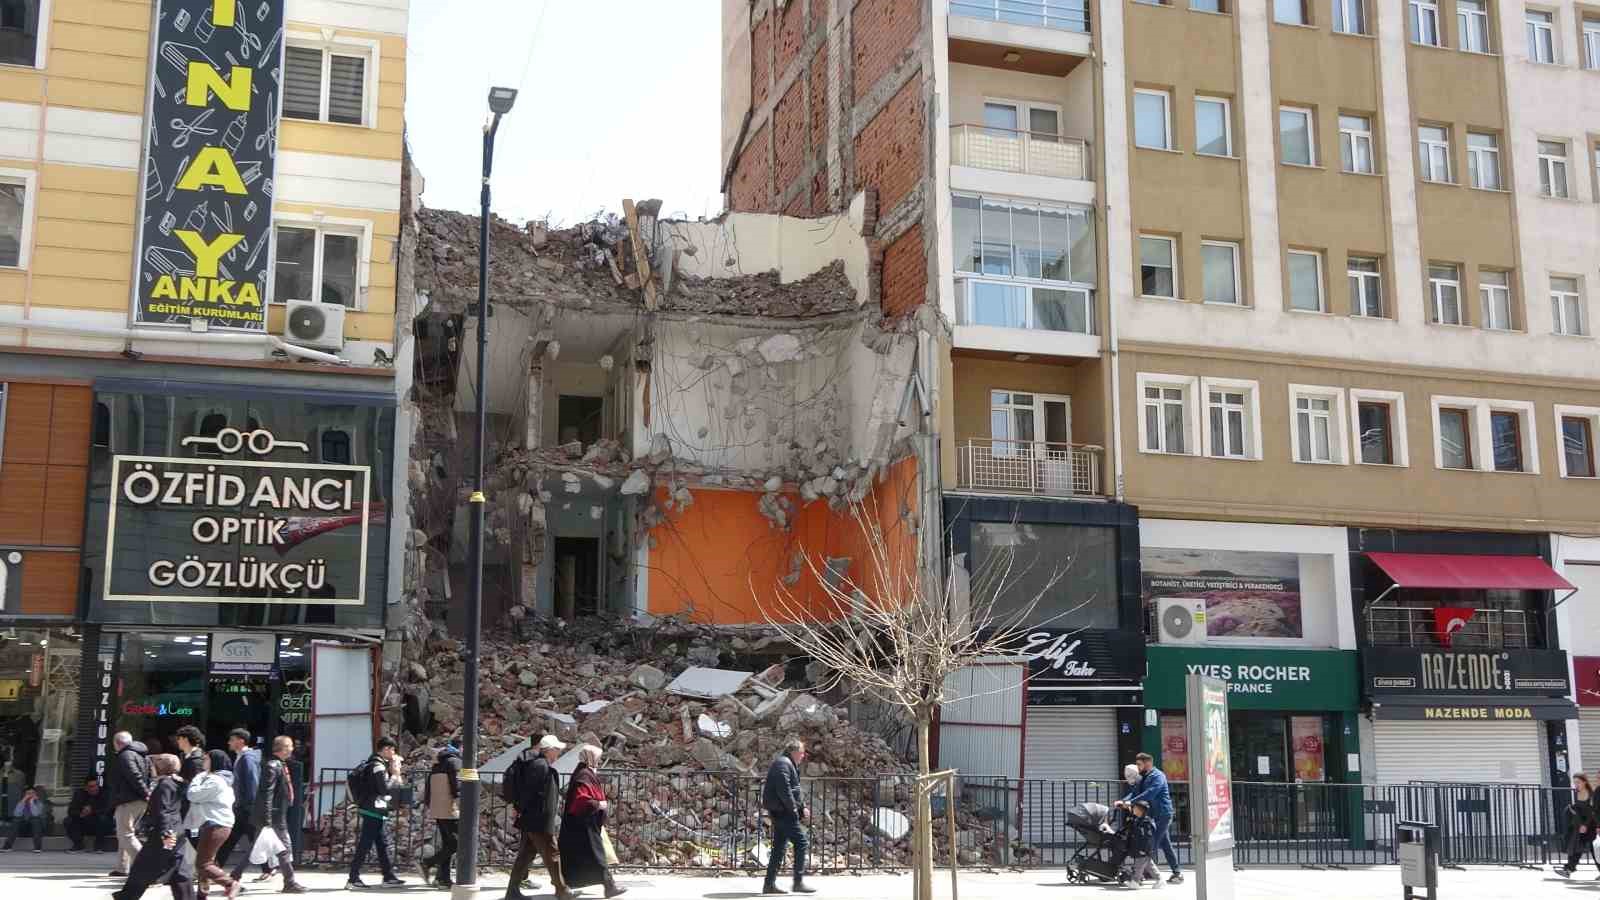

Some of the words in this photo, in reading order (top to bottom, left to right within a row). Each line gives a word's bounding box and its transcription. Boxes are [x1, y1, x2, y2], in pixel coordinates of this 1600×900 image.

[151, 275, 261, 307] ANKA
[148, 303, 191, 315] EĞİTİM
[193, 307, 262, 321] KURUMLARI
[192, 512, 289, 545] OPTİK
[148, 556, 326, 594] GÖZLÜKÇÜ
[224, 645, 255, 656] SGK
[1018, 632, 1081, 669] Elif
[1187, 664, 1232, 679] YVES
[1238, 665, 1311, 681] ROCHER
[1421, 653, 1503, 690] NAZENDE
[1227, 683, 1273, 694] FRANCE
[1425, 707, 1488, 718] NAZENDE
[1495, 708, 1532, 718] MODA
